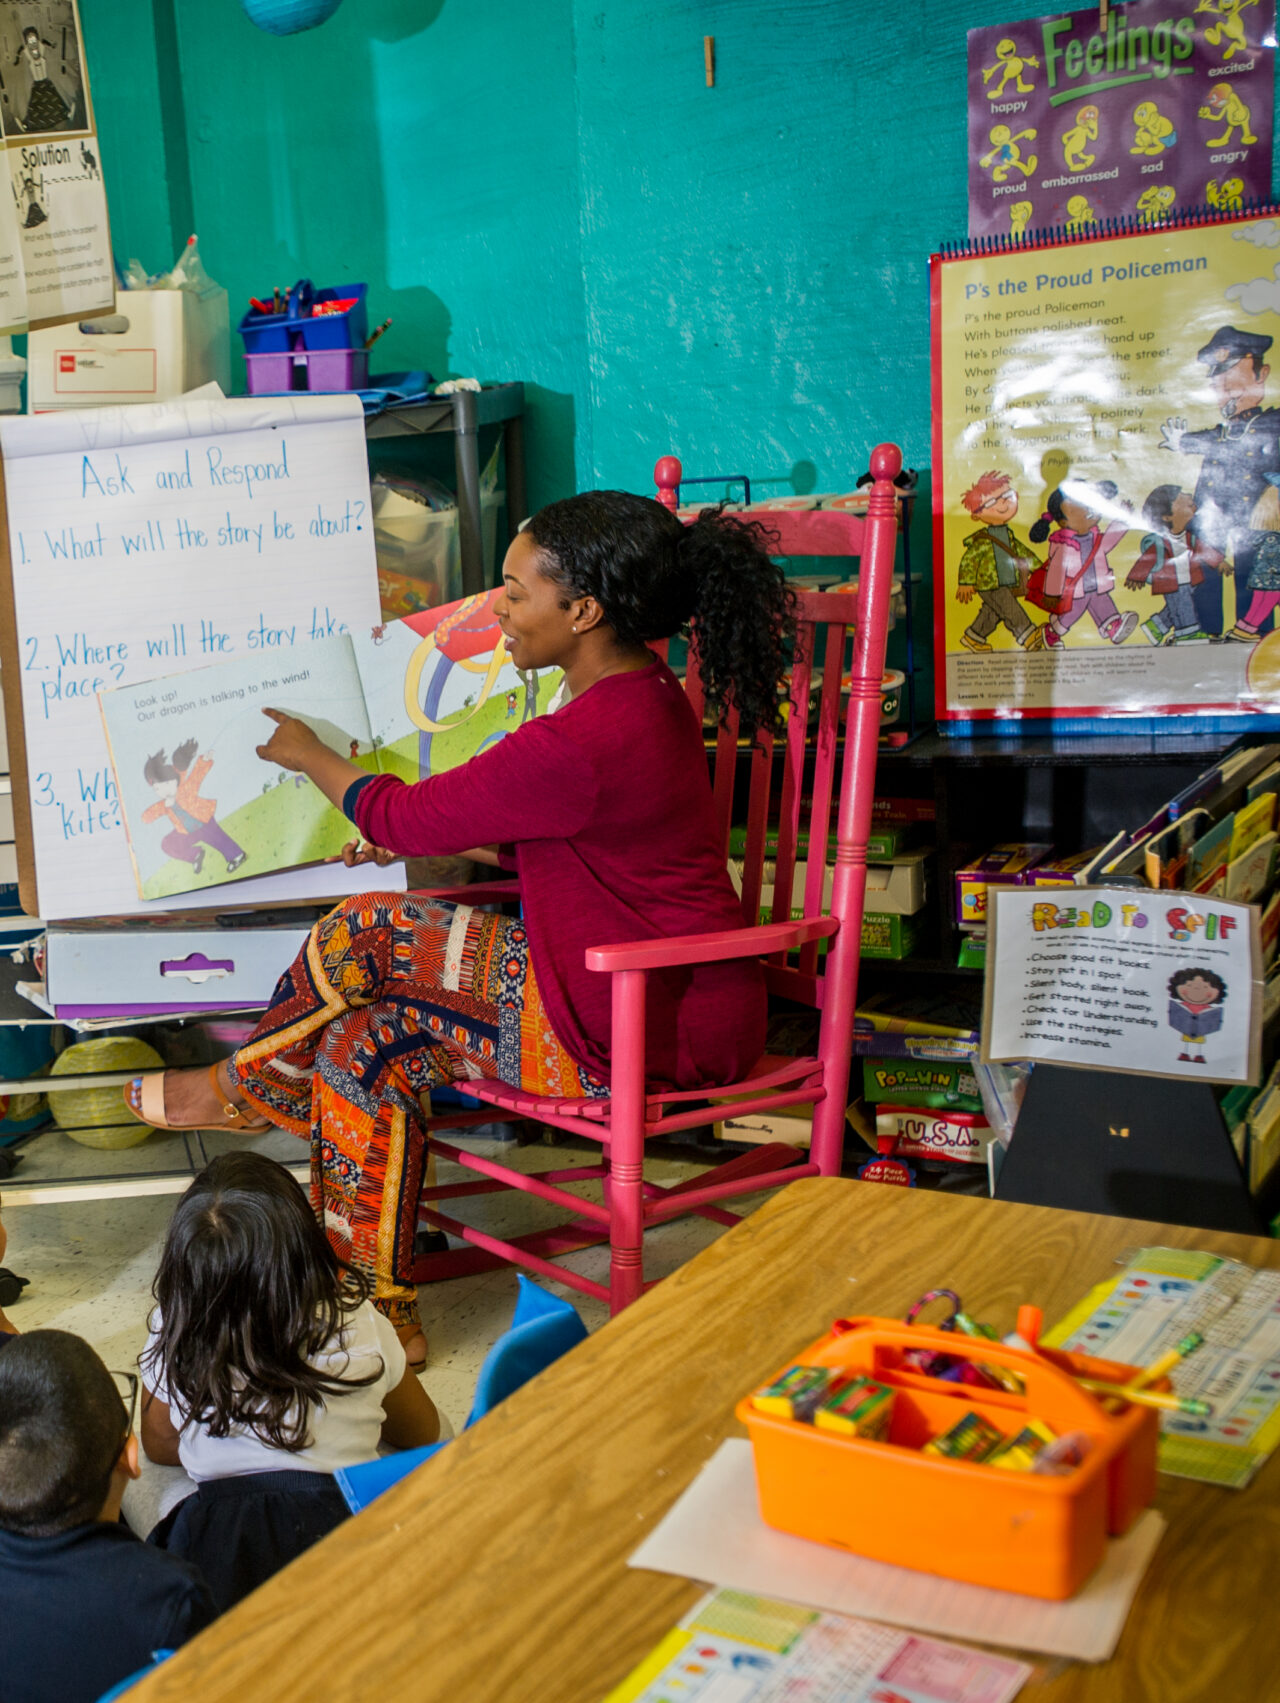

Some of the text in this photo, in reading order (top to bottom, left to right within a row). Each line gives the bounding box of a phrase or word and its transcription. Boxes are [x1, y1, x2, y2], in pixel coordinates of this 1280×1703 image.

[1041, 10, 1196, 89] Feelings
[1207, 59, 1256, 77] excited
[990, 100, 1029, 114] happy
[20, 144, 72, 170] Solution
[1141, 161, 1165, 174] sad
[1210, 149, 1250, 165] angry
[1041, 167, 1120, 190] embarrassed
[992, 181, 1028, 198] proud
[965, 256, 1208, 300] P's the Proud Policeman
[983, 310, 1002, 321] the
[1005, 305, 1041, 321] proud
[1045, 299, 1106, 315] Policeman
[963, 314, 1127, 342] With buttons polished neat.
[1103, 331, 1135, 345] hand
[1138, 331, 1156, 344] up
[81, 439, 290, 500] Ask and Respond
[19, 500, 366, 566] 1. What will the story be about?
[24, 636, 51, 672] 2.
[55, 632, 129, 668] Where
[146, 622, 187, 658] will
[200, 619, 235, 654] the
[246, 612, 297, 650] story
[133, 688, 179, 709] Look up!
[137, 669, 312, 723] Our dragon is talking to the wind!
[34, 771, 62, 808] 3.
[60, 800, 121, 841] kite?
[1031, 953, 1068, 963] Choose
[1070, 954, 1096, 963] good
[1099, 955, 1115, 964] fit
[1030, 966, 1055, 976] Stay
[1057, 967, 1076, 975] put
[1079, 968, 1089, 976] in
[1029, 979, 1057, 988] Silent
[1090, 983, 1119, 992] silent
[1026, 1004, 1059, 1014] Check
[1062, 1007, 1080, 1016] for
[1028, 993, 1047, 1001] Get
[1050, 992, 1092, 1004] started
[1094, 995, 1121, 1009] right
[1047, 1019, 1065, 1029] the
[1023, 1031, 1066, 1042] Increase
[905, 1118, 980, 1148] U.S.A.
